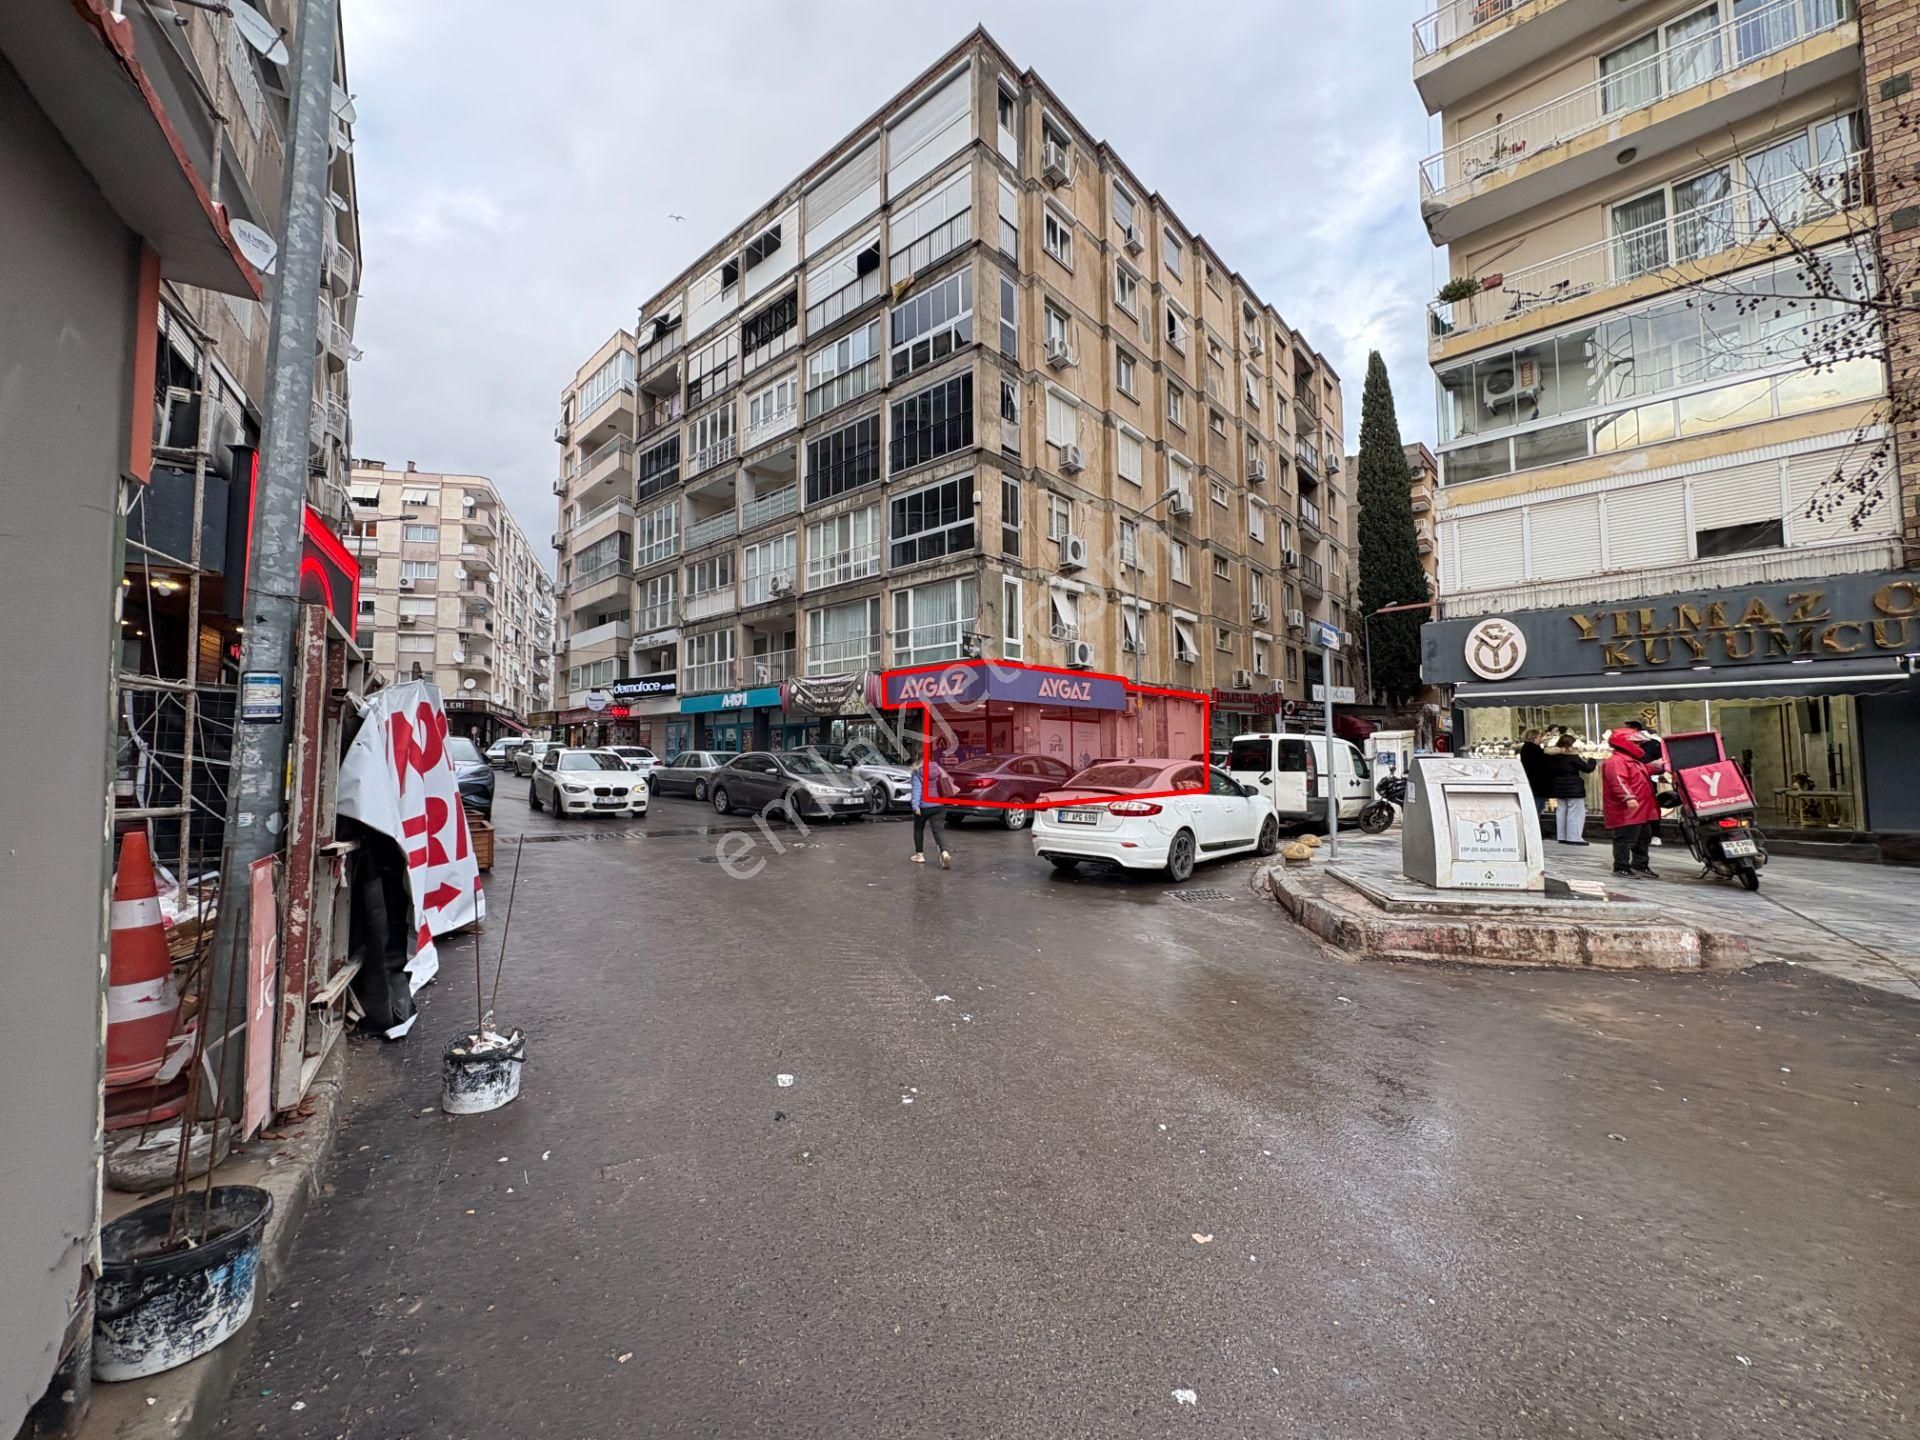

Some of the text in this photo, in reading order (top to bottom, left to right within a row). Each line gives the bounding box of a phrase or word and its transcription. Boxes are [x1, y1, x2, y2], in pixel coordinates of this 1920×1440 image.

[1569, 592, 1831, 640] YILMAZ
[1602, 616, 1913, 668] KUYUMCU
[899, 672, 965, 700] AYGAZ
[1038, 677, 1092, 700] AYGAZ
[1701, 771, 1721, 797] Y
